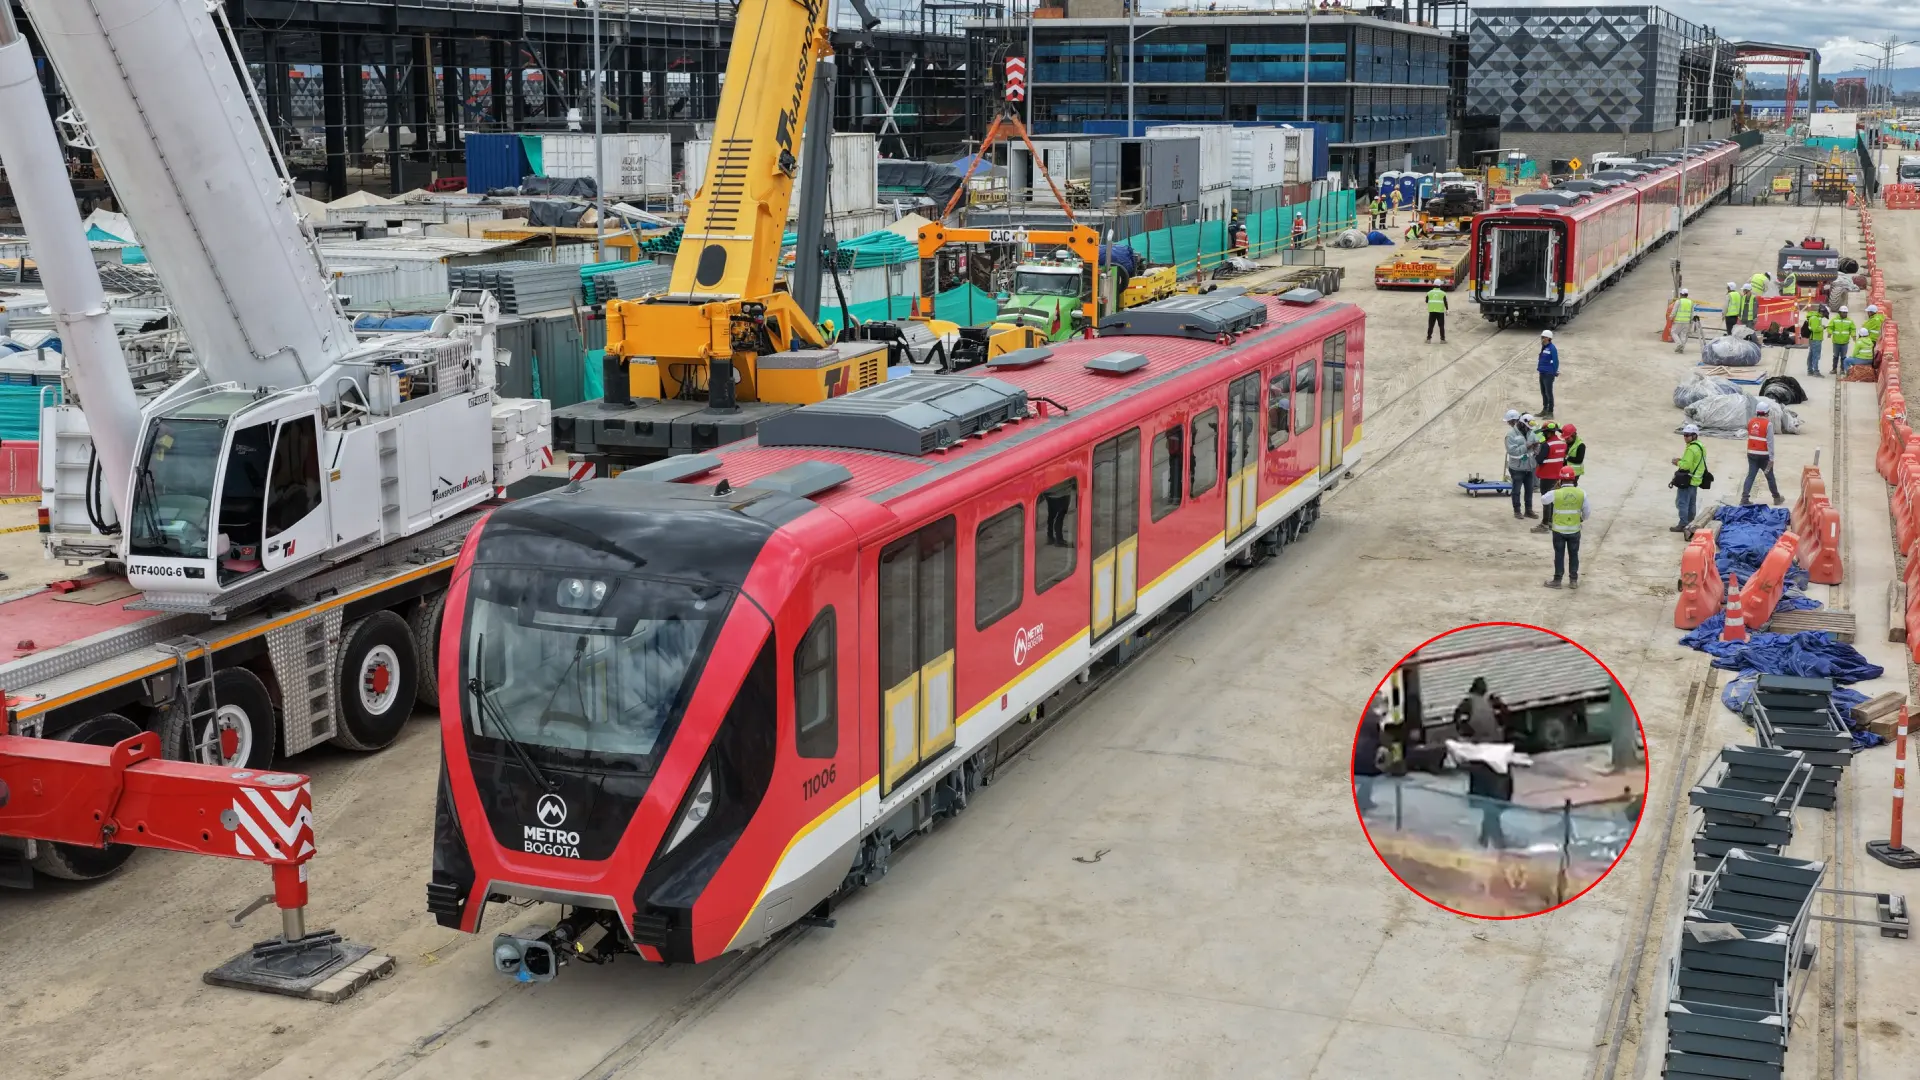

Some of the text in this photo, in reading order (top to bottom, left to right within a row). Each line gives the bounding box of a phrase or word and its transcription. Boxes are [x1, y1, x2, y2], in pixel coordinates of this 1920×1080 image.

[1027, 622, 1044, 641] METRO
[803, 763, 836, 802] 11006
[523, 825, 580, 846] METRO
[524, 840, 581, 859] BOGOTA
